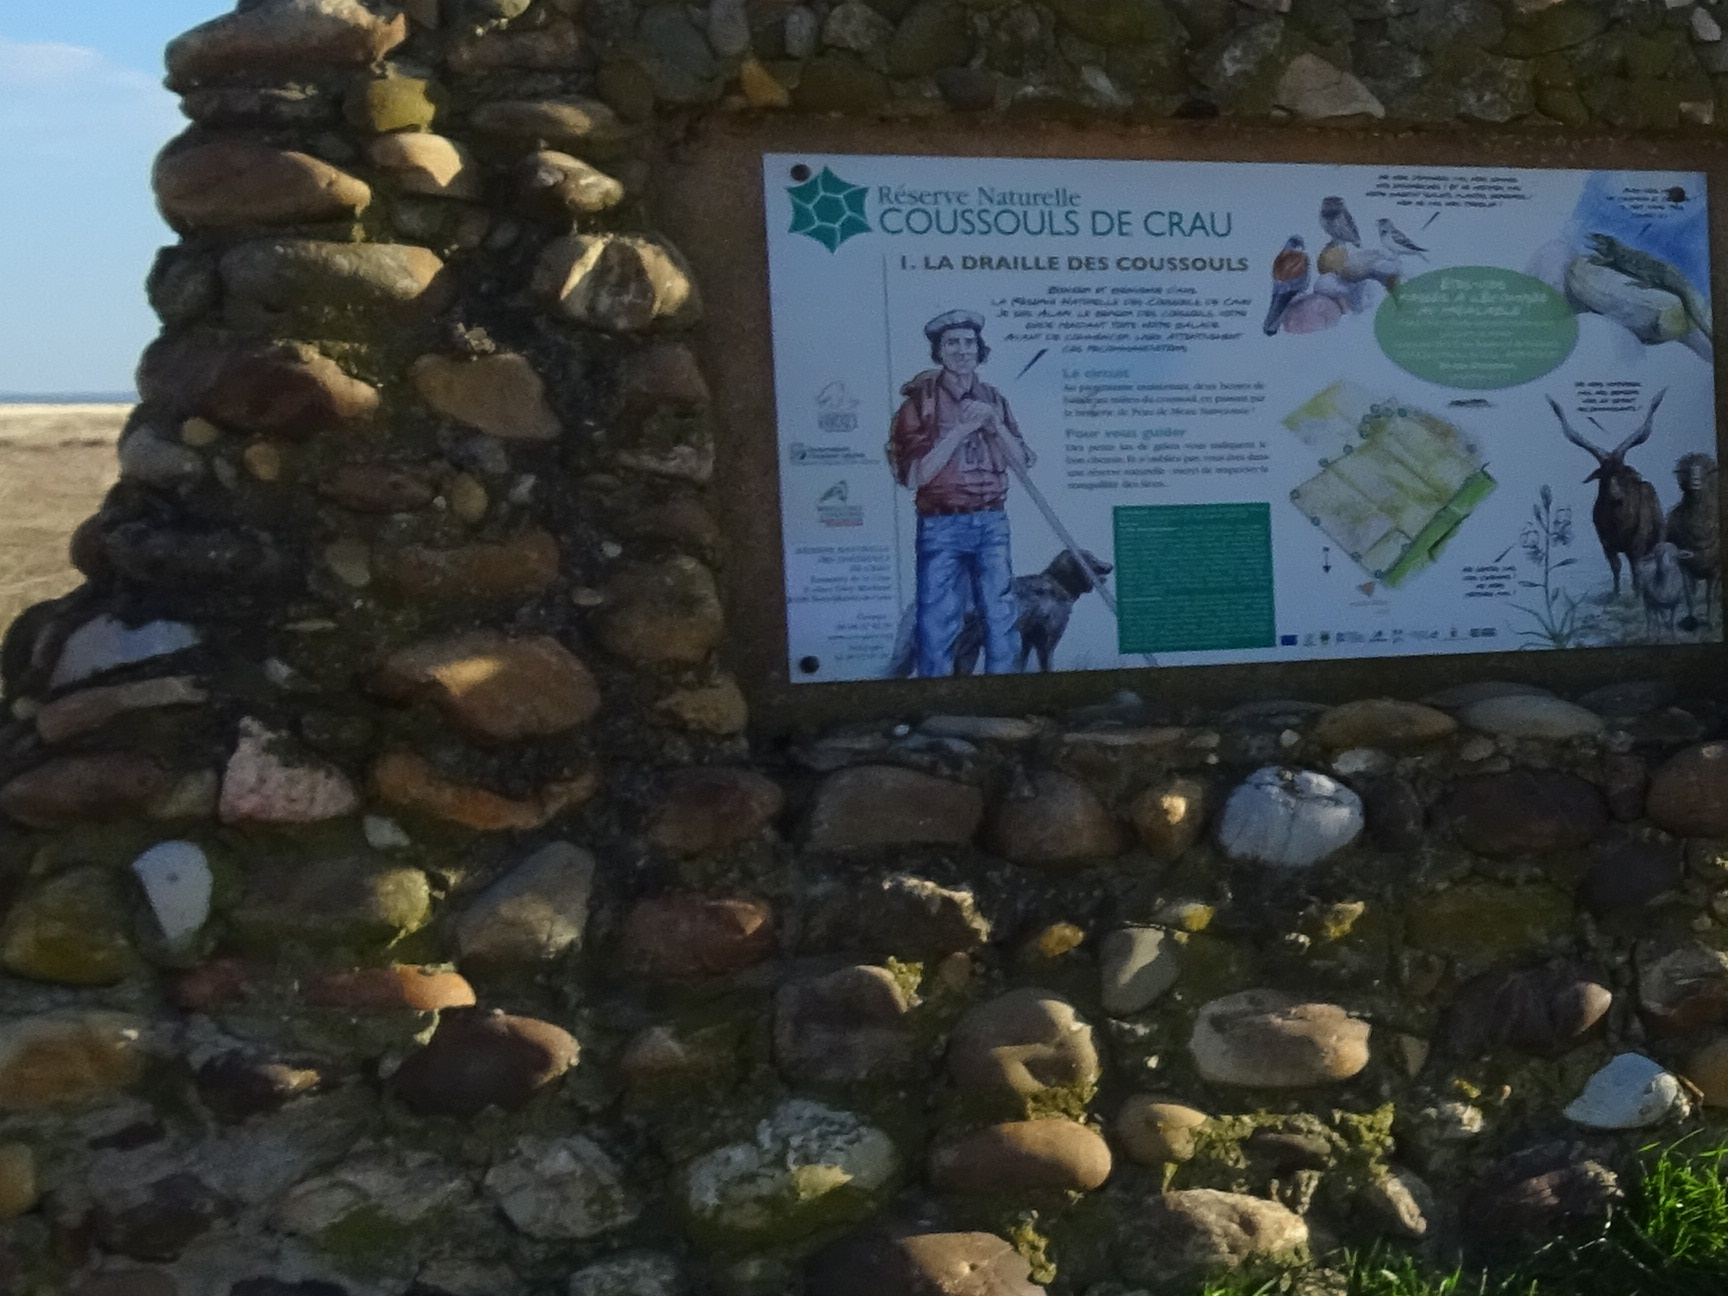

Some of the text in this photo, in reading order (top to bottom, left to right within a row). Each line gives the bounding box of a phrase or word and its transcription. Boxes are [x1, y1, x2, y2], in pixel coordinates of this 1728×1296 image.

[878, 185, 1082, 208] Réserve Naturelle
[879, 207, 1233, 239] COUSSOULS DE CRAU
[923, 255, 954, 272] LA
[961, 256, 1058, 272] DRAILLE
[1067, 256, 1110, 273] DES
[1115, 256, 1250, 274] COUSSOULS
[1065, 428, 1100, 440] Pour
